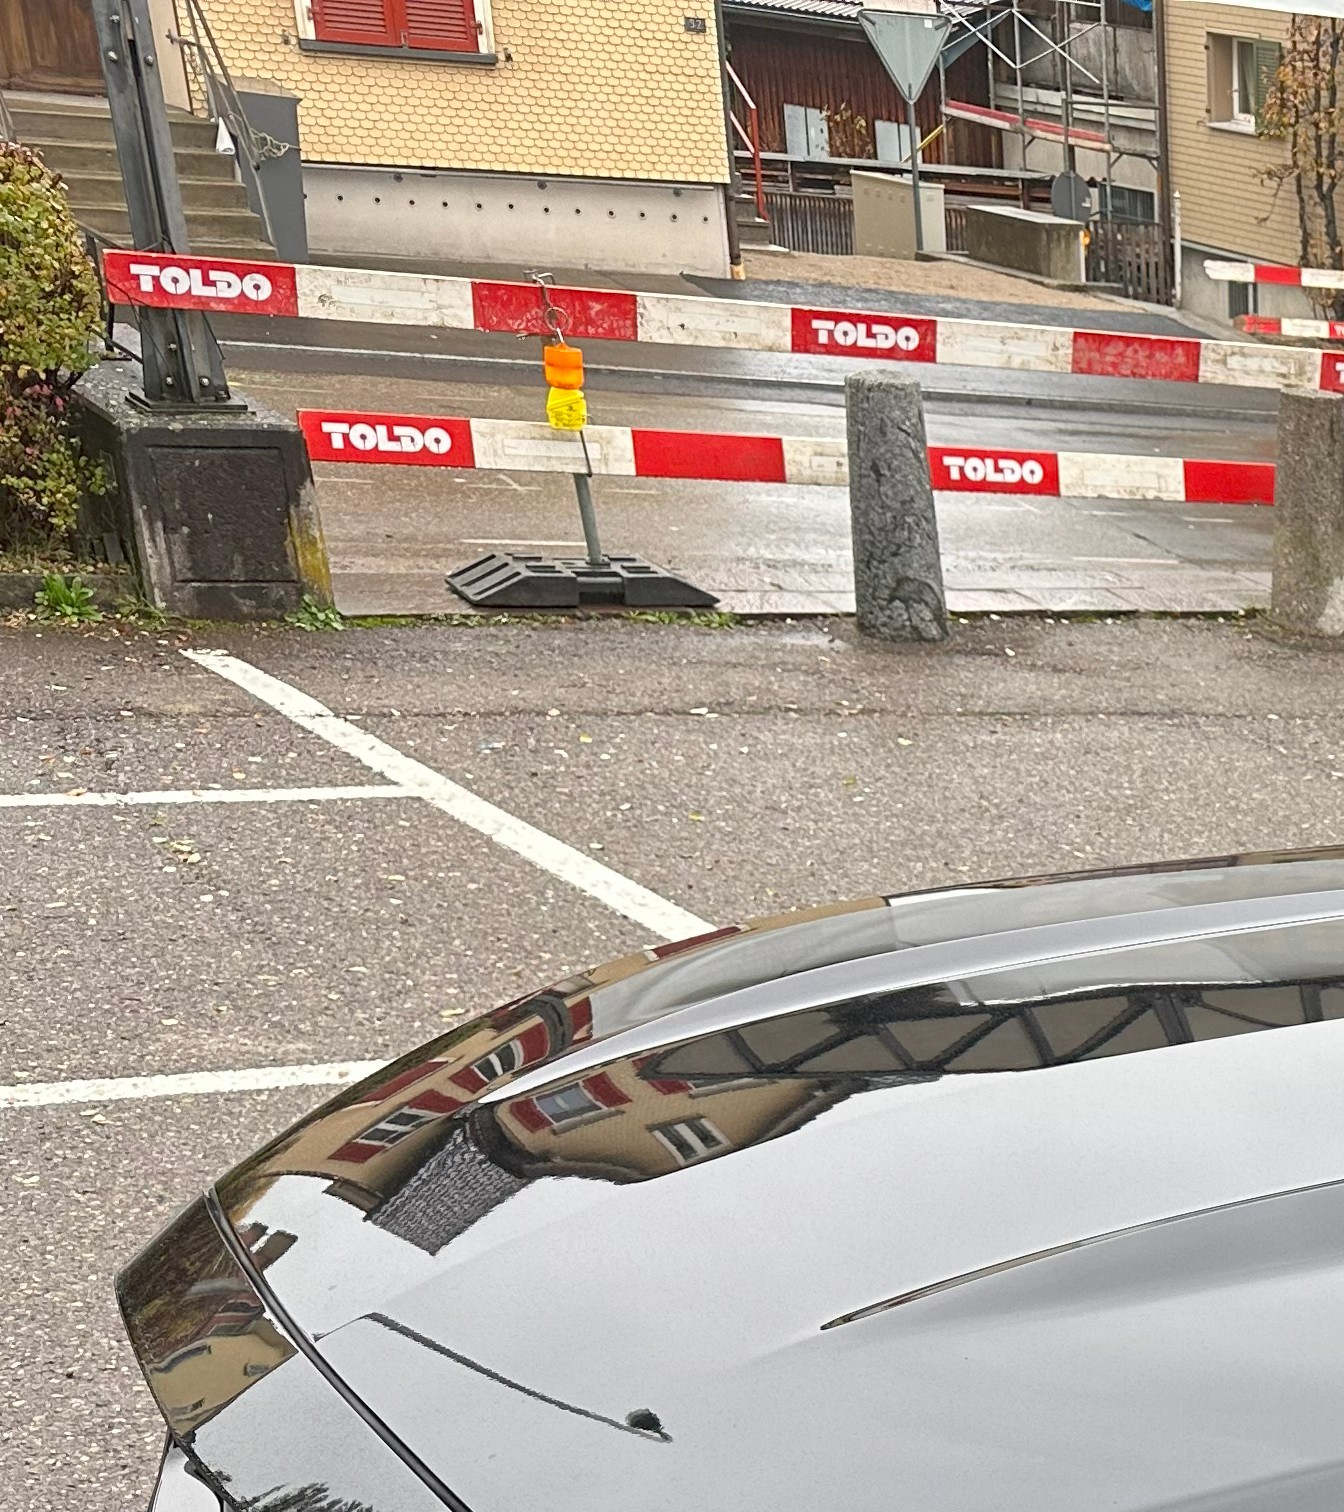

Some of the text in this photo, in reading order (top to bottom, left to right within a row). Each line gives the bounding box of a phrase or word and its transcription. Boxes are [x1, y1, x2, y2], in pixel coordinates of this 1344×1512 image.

[129, 263, 273, 301] TOLDO
[811, 319, 920, 351] TOLDO
[321, 421, 452, 454] TOLDO
[942, 455, 1044, 485] TOLDO
